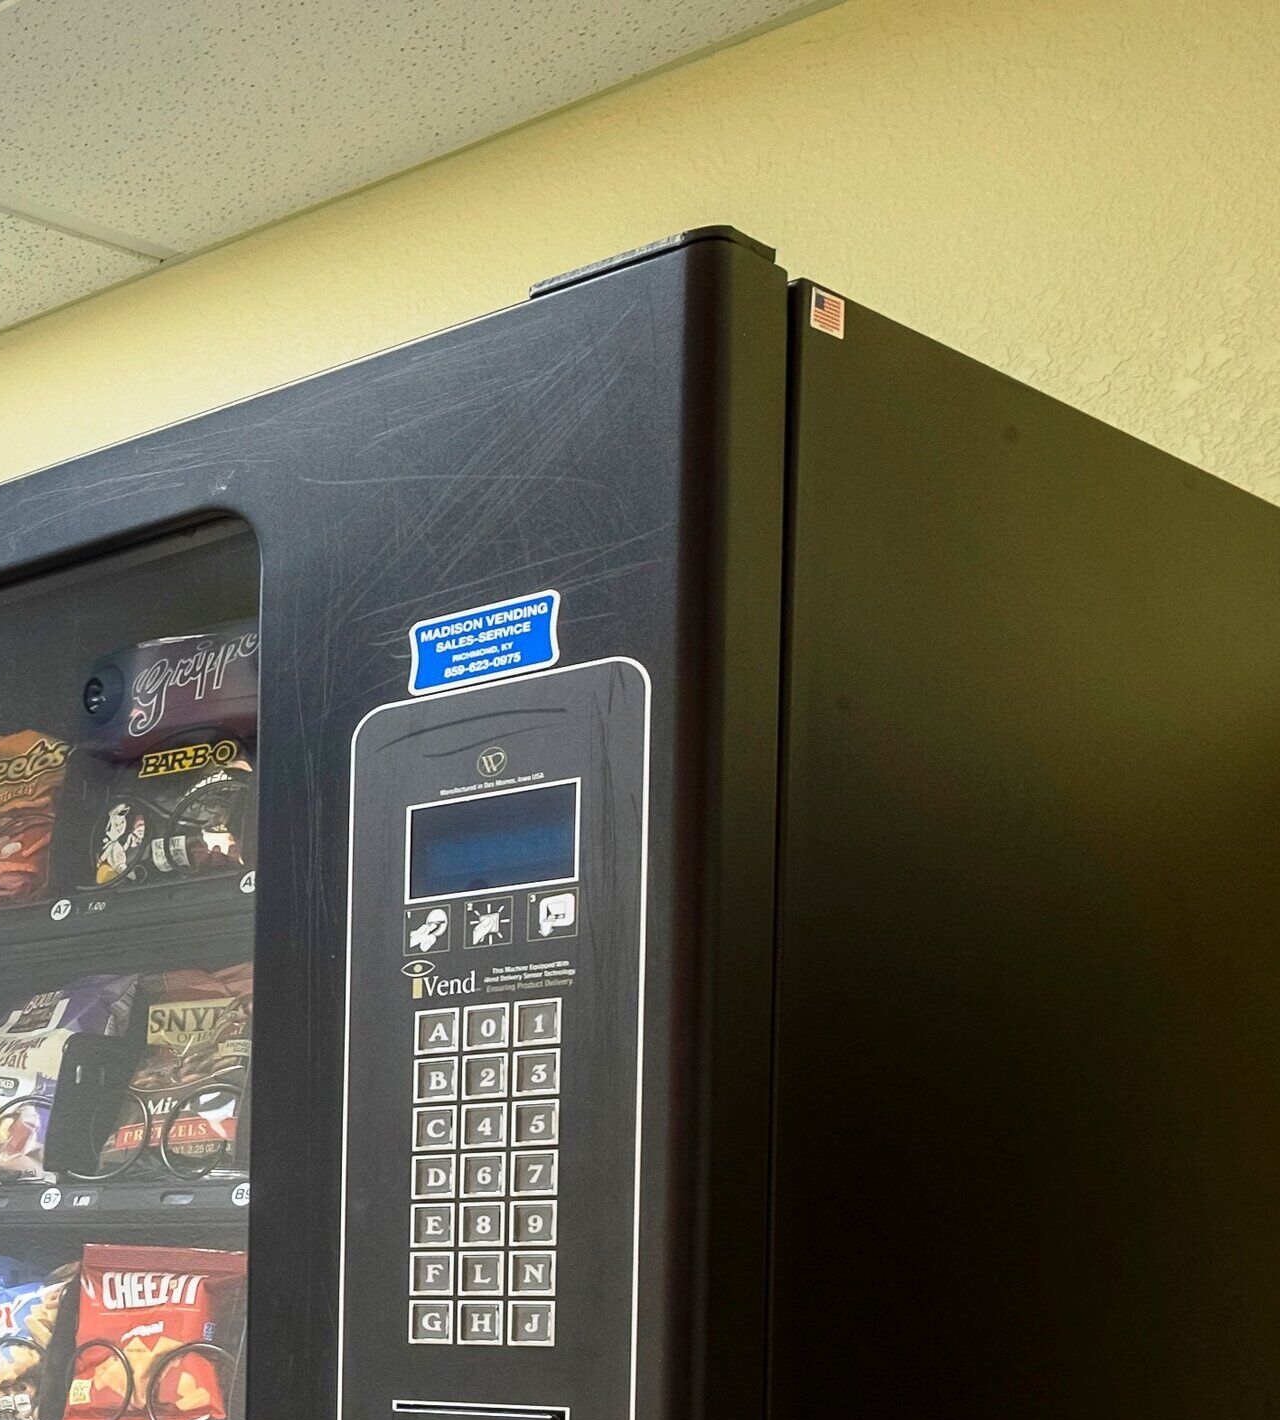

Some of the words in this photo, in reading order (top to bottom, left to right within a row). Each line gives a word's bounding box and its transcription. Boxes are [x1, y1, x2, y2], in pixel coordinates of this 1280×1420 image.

[420, 617, 483, 643] MADISON
[486, 601, 549, 628] VENDING
[435, 621, 532, 653] SALES-SERVICE
[501, 641, 514, 652] KY
[443, 651, 521, 679] 859-623-0975
[140, 741, 237, 777] BAR-B-Q
[52, 903, 70, 917] A7
[428, 1022, 449, 1042] A
[534, 1015, 544, 1033] 1
[428, 1071, 448, 1090] B
[479, 1068, 495, 1087] 2
[530, 1064, 547, 1083] 3
[426, 1119, 446, 1138] C
[477, 1117, 492, 1136] 4
[529, 1114, 546, 1134] 5
[427, 1168, 447, 1187] D
[476, 1166, 492, 1185] 6
[527, 1164, 543, 1184] 7
[44, 1192, 60, 1204] B7
[425, 1216, 444, 1235] E
[476, 1215, 491, 1234] 8
[527, 1215, 544, 1233] 9
[425, 1264, 444, 1283] F
[473, 1264, 492, 1283] L
[523, 1263, 545, 1283] N
[421, 1312, 442, 1331] G
[471, 1313, 492, 1332] H
[524, 1314, 541, 1333] J
